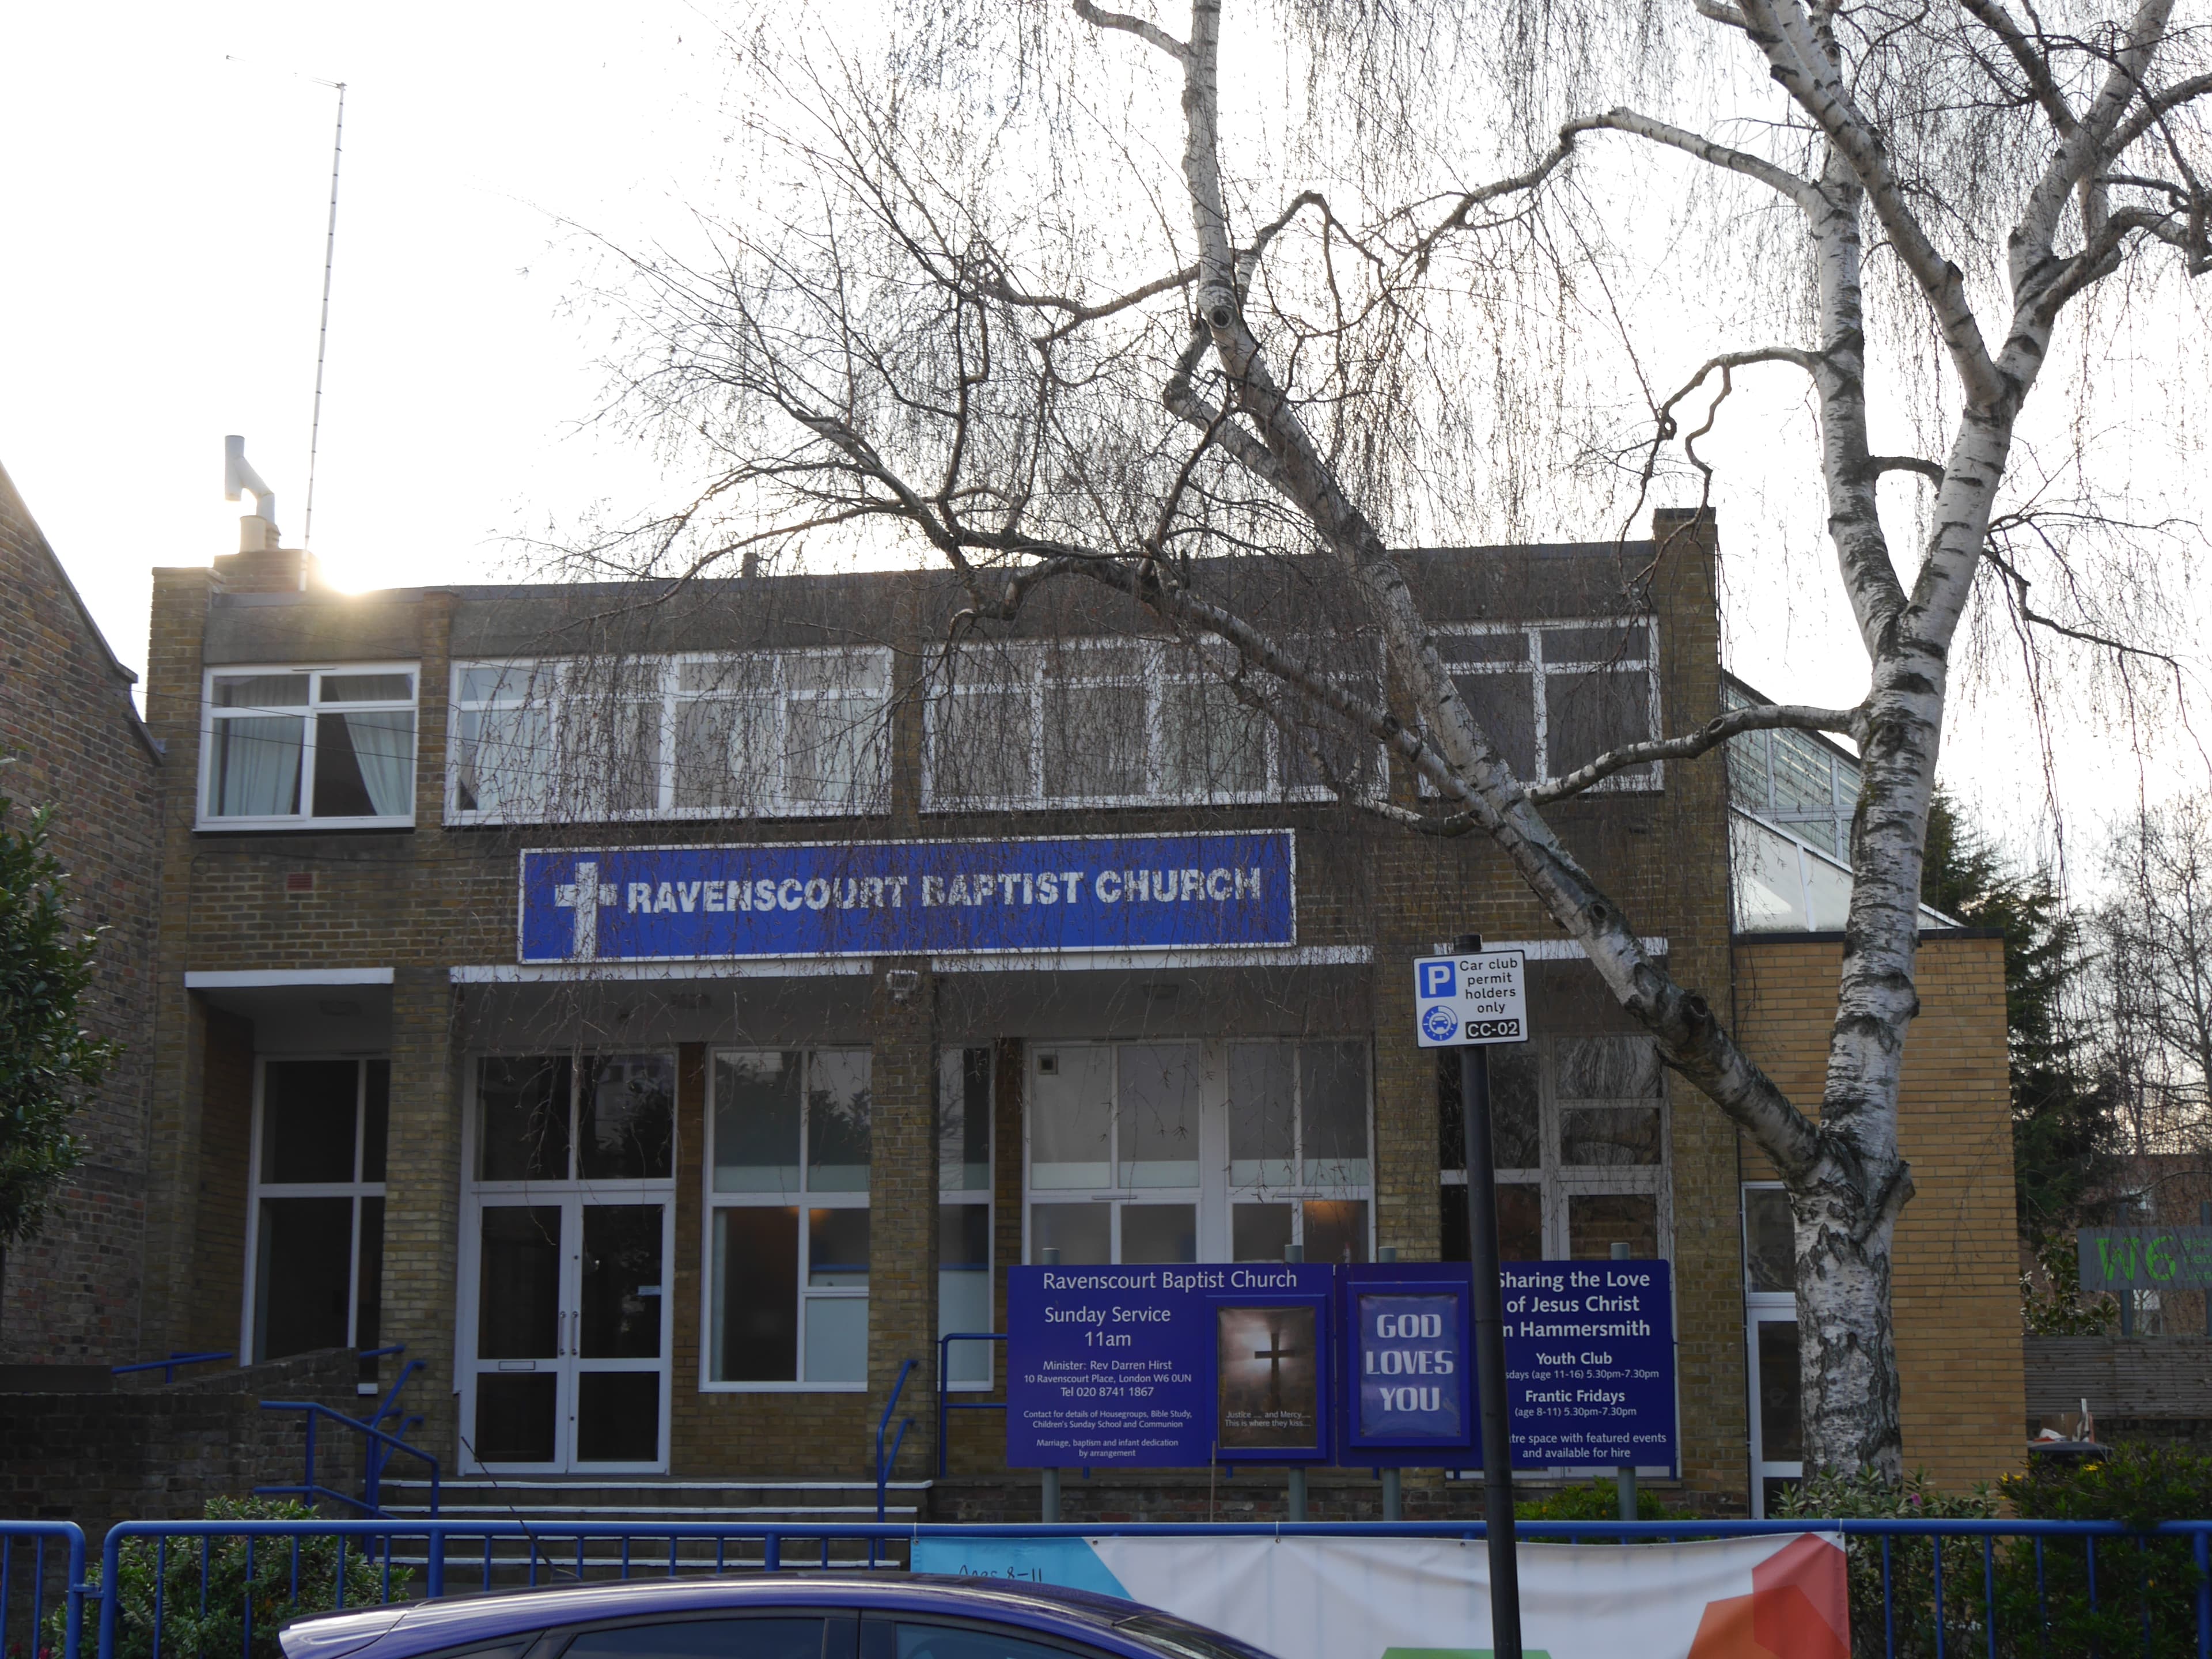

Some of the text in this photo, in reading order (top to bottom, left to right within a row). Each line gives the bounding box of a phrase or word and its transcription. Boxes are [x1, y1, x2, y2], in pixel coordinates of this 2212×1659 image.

[627, 867, 1260, 914] RAVENSCOURT BAPTIST CHURCH
[1459, 957, 1518, 971] Car club
[1427, 965, 1451, 995] P
[1467, 972, 1512, 987] permit
[1465, 988, 1516, 999] holders
[1477, 1001, 1506, 1014] only
[1467, 1021, 1518, 1037] CC-02
[2093, 1235, 2177, 1282] W6
[1043, 1269, 1297, 1293] Ravenscourt Baptist Church
[1569, 1270, 1600, 1287] the
[1607, 1271, 1650, 1287] Love
[1506, 1295, 1640, 1313] of Jesus Christ
[1045, 1305, 1171, 1327] Sunday Service
[1377, 1314, 1441, 1338] GOD
[1520, 1319, 1650, 1337] Hammersmith
[1085, 1331, 1131, 1346] 11am
[1043, 1360, 1172, 1370] Minister: Rev Darren Hirst
[1366, 1350, 1453, 1375] LOVES
[1536, 1351, 1612, 1365] Youth Club
[1024, 1373, 1191, 1383] 10 Ravenscourt Place, London W6 0UN
[1531, 1370, 1551, 1381] (age
[1554, 1369, 1584, 1379] 11-16)
[1586, 1369, 1660, 1380] 5.30pm-7.30pm
[1060, 1387, 1154, 1397] Tel 020 8741 1867
[1378, 1387, 1440, 1411] YOU
[1525, 1388, 1625, 1406] Frantic Fridays
[1023, 1410, 1192, 1419] Contact for details of Housegroups, Bible Study,
[1226, 1410, 1252, 1419] Justice
[1514, 1407, 1637, 1419] (age 8-11) 5.30pm-7.30pm
[1032, 1420, 1183, 1430] Children's Sunday School and Communion
[1225, 1419, 1240, 1427] This
[1248, 1419, 1270, 1427] where
[1271, 1419, 1287, 1428] they
[1036, 1438, 1179, 1449] Marriage, baptism and infant dedication
[1528, 1435, 1558, 1446] space
[1560, 1433, 1583, 1443] with
[1586, 1432, 1630, 1443] featured
[1633, 1433, 1666, 1443] events
[1078, 1449, 1136, 1459] by arrangement
[1522, 1446, 1631, 1458] and available for hire
